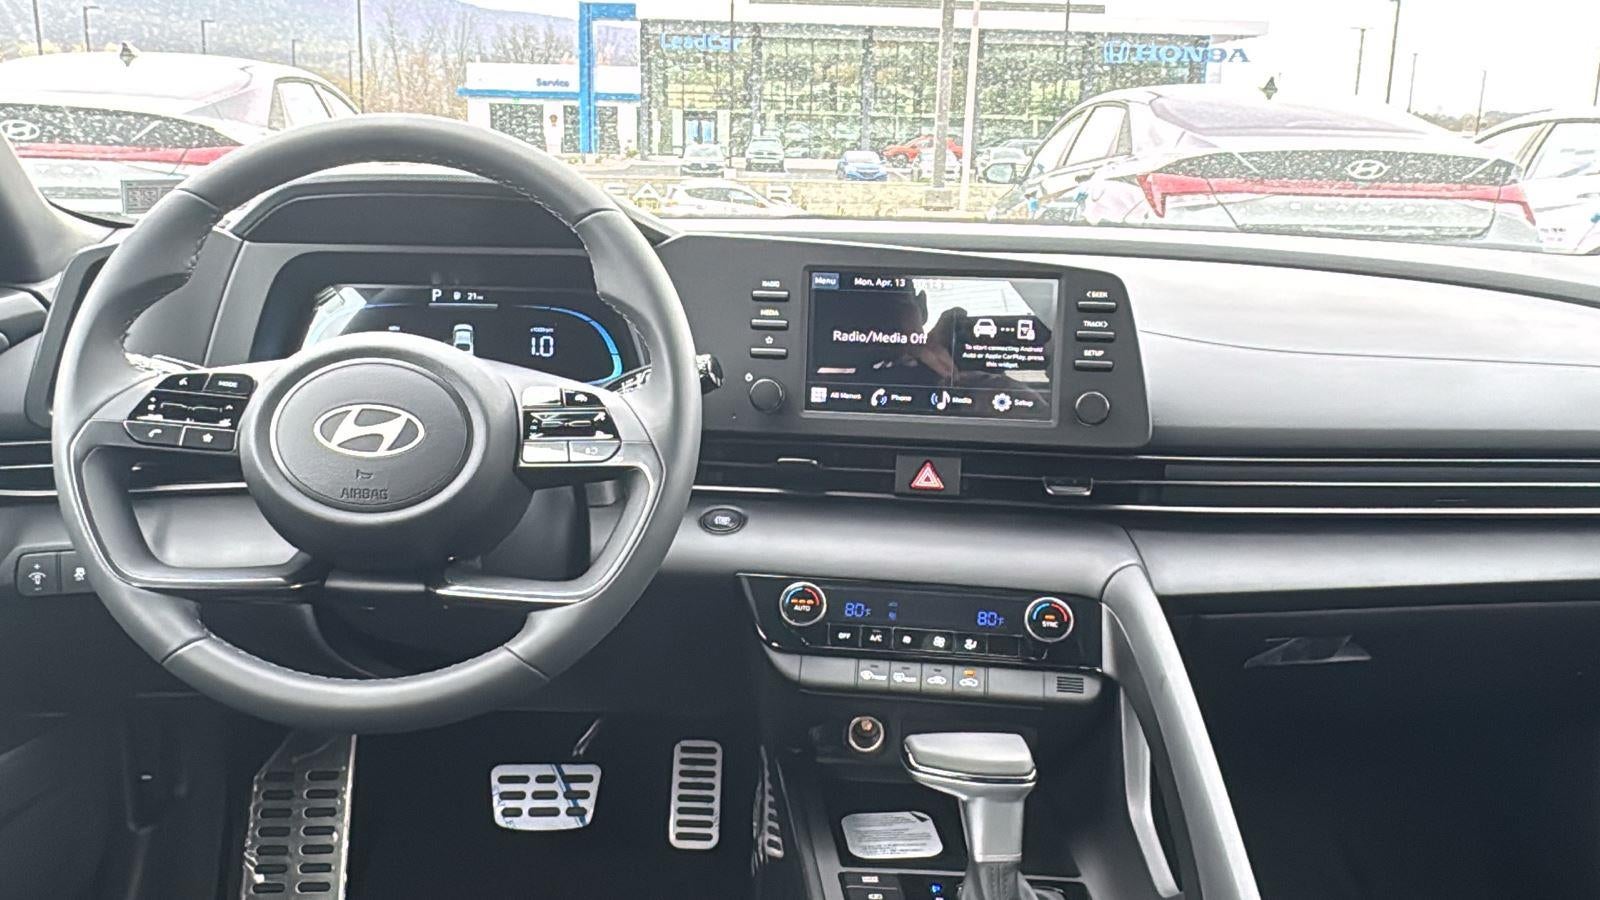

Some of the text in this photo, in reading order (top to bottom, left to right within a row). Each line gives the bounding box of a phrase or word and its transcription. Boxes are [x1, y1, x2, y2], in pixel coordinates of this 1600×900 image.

[660, 32, 741, 53] LeadCar
[1134, 43, 1250, 63] HONDA
[536, 78, 570, 88] Service
[814, 276, 837, 285] Menu
[854, 277, 875, 287] Mon.
[876, 279, 893, 288] Apr.
[895, 278, 906, 288] 13
[432, 288, 442, 302] P
[832, 329, 928, 345] Radio/Media Off
[531, 335, 554, 357] 1.0
[965, 343, 973, 351] To
[891, 394, 912, 403] Phone
[952, 396, 973, 405] Media
[1014, 398, 1035, 408] Setup
[340, 487, 389, 501] AIRBAG
[1041, 620, 1060, 629] SYNC
[838, 632, 852, 640] OFF
[869, 634, 883, 643] A/C
